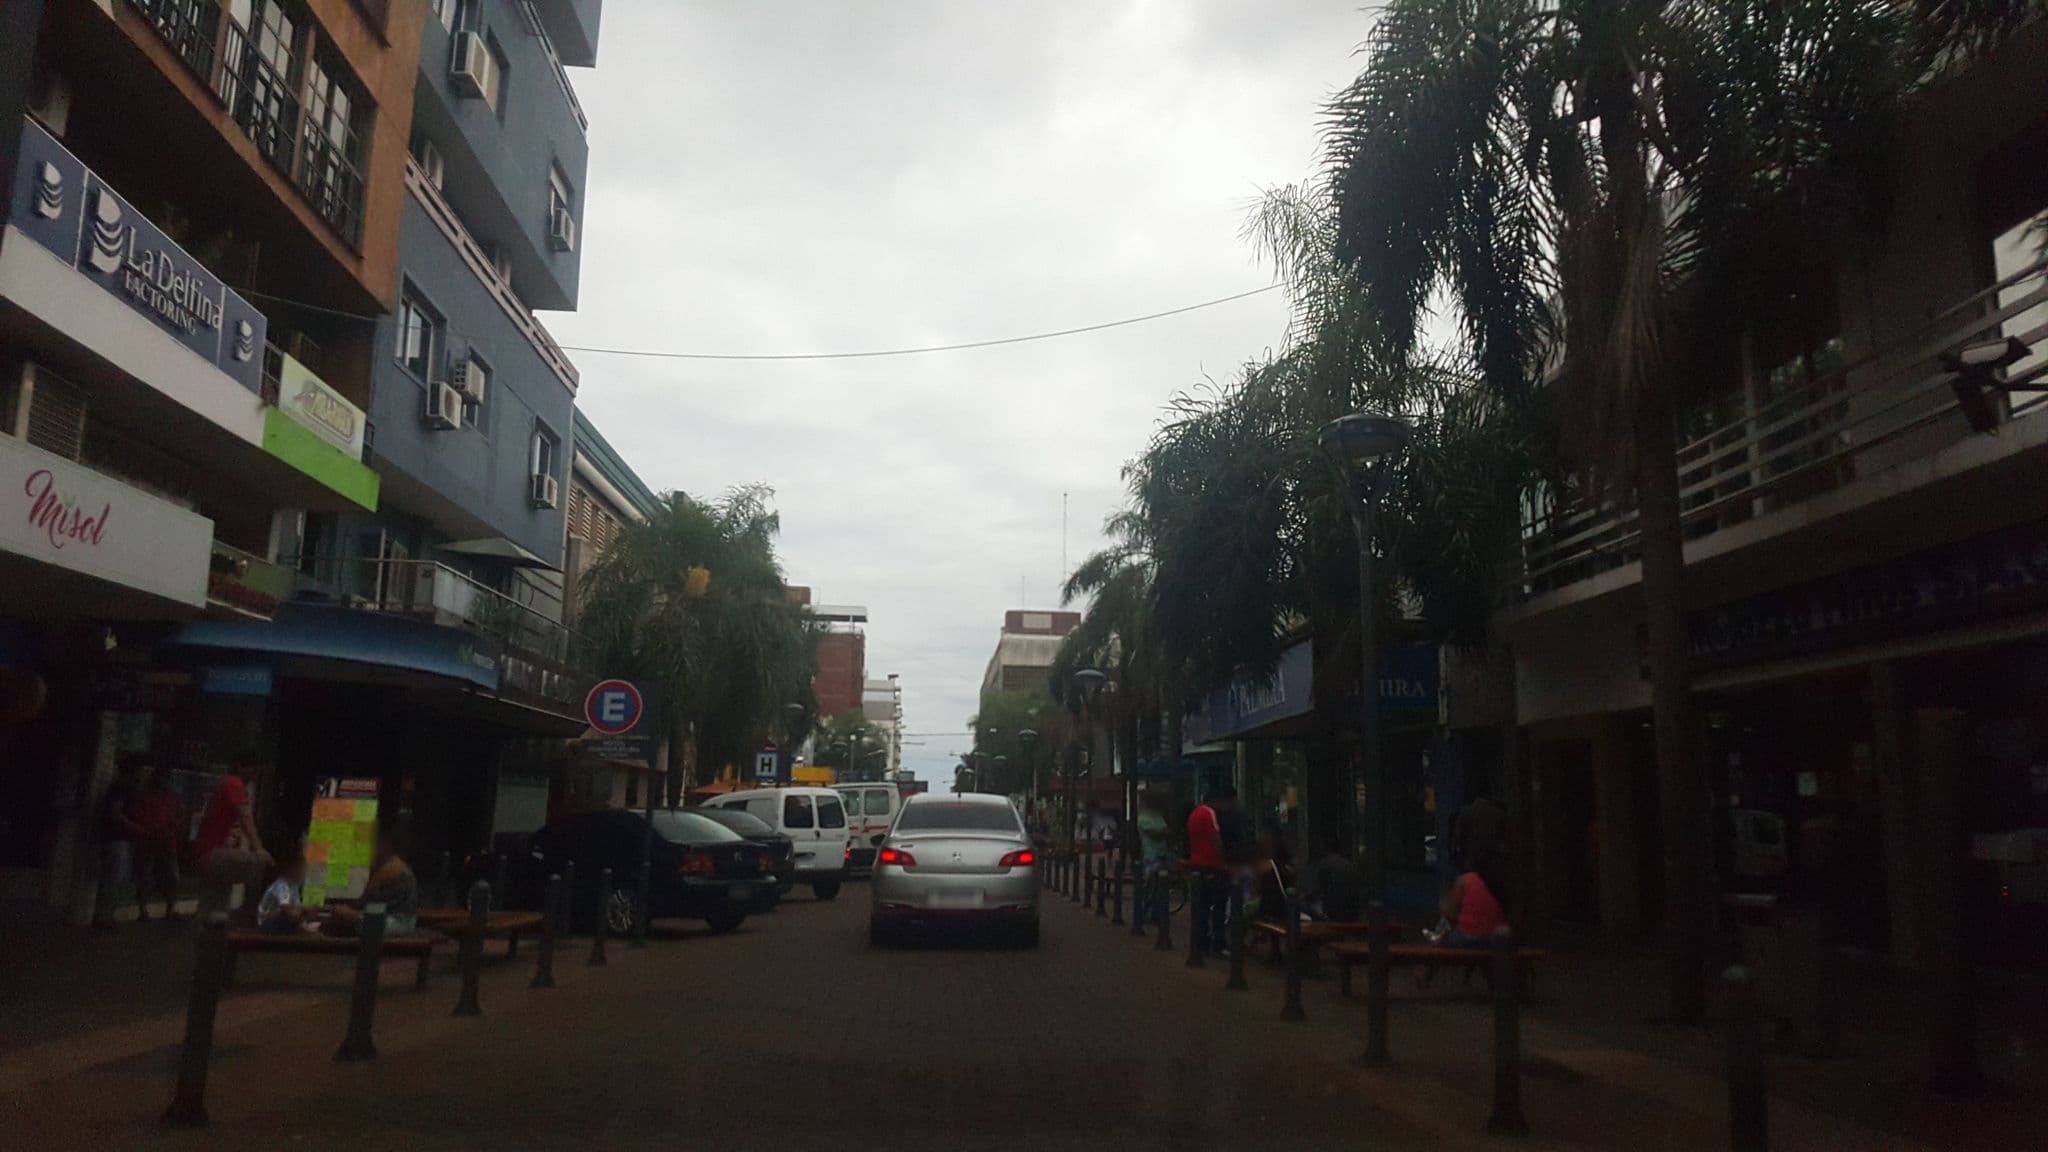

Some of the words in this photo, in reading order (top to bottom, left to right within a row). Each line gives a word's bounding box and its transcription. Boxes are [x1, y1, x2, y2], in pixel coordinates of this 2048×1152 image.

[125, 270, 198, 336] FACTORING
[127, 226, 153, 279] La
[157, 250, 222, 329] Delfina
[25, 469, 110, 549] Misol
[602, 691, 625, 722] E
[761, 757, 772, 772] H
